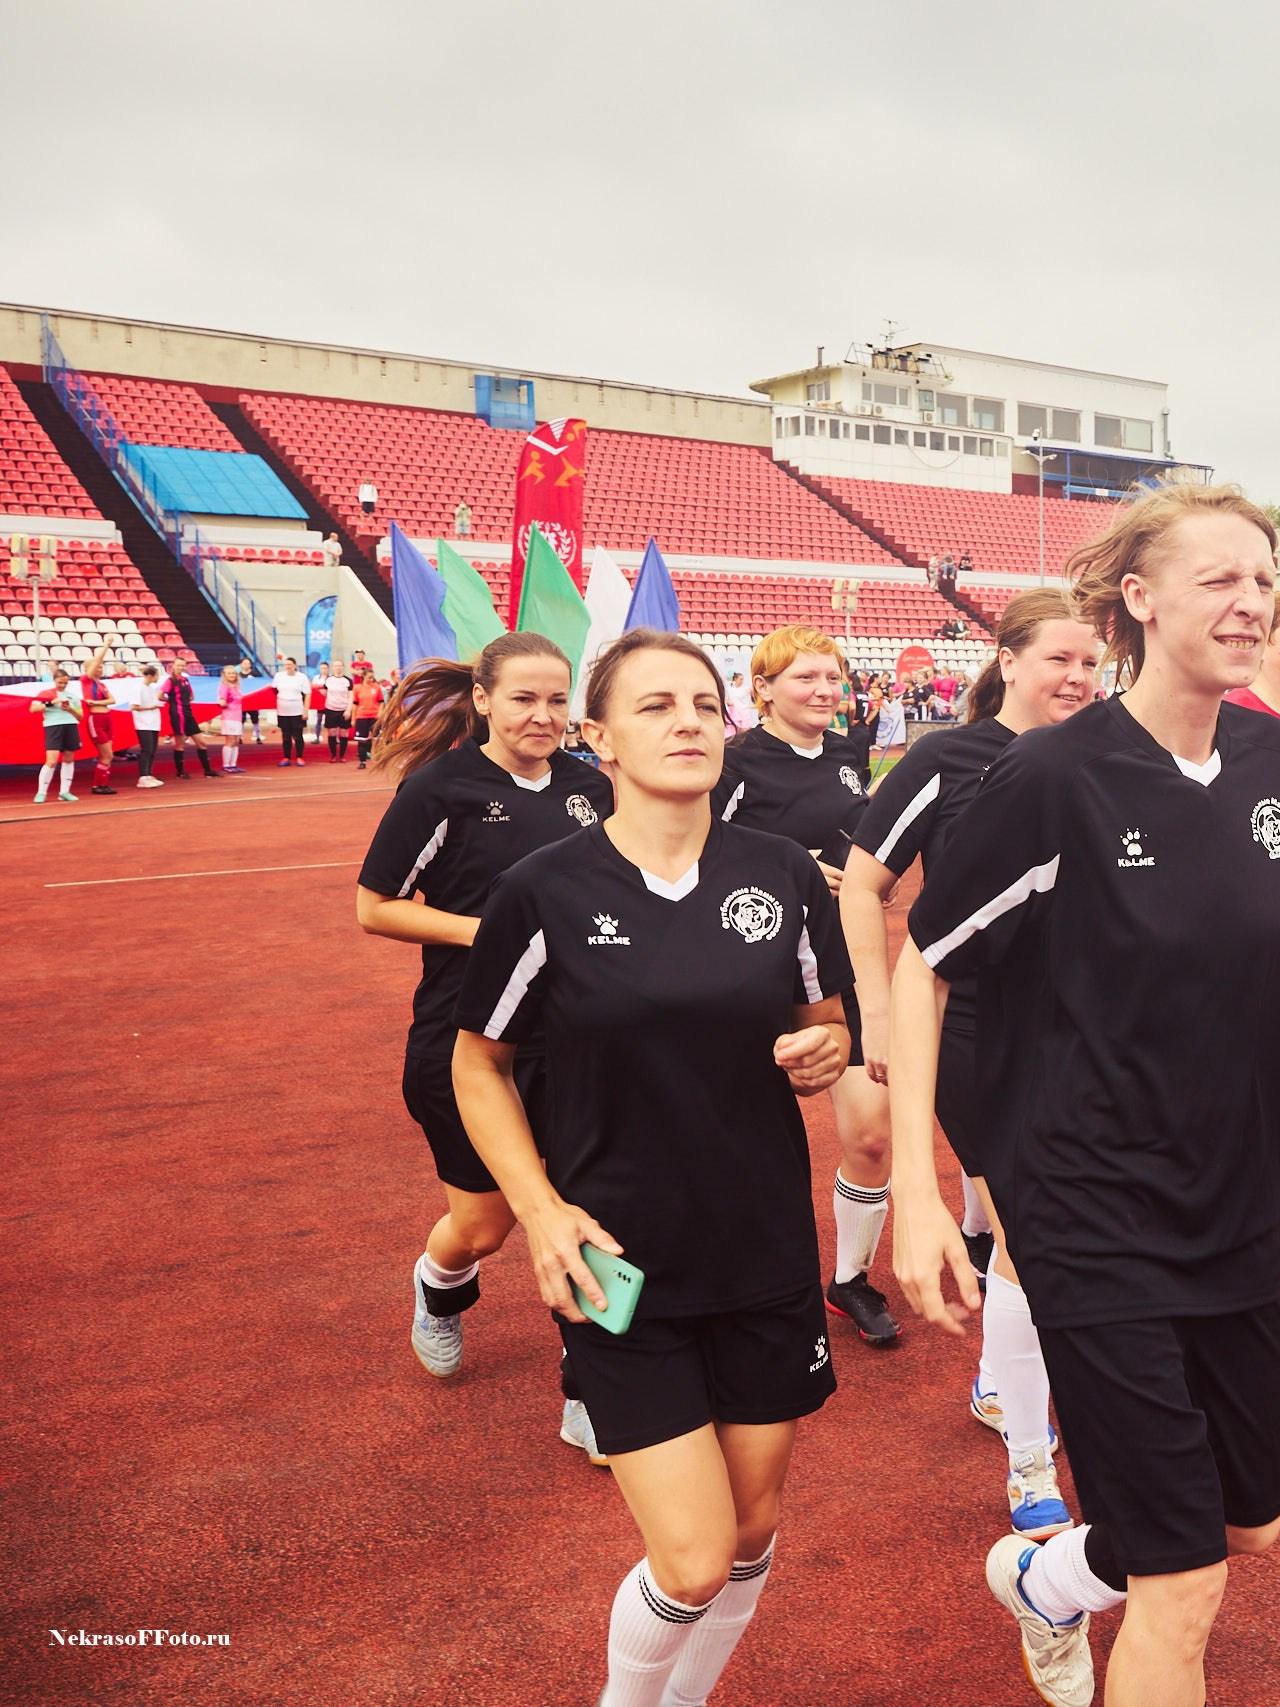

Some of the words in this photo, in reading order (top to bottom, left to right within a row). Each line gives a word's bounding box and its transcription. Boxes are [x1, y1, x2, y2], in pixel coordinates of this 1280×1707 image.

[862, 702, 869, 718] 7
[1117, 856, 1156, 868] KELME
[587, 935, 631, 946] KELME
